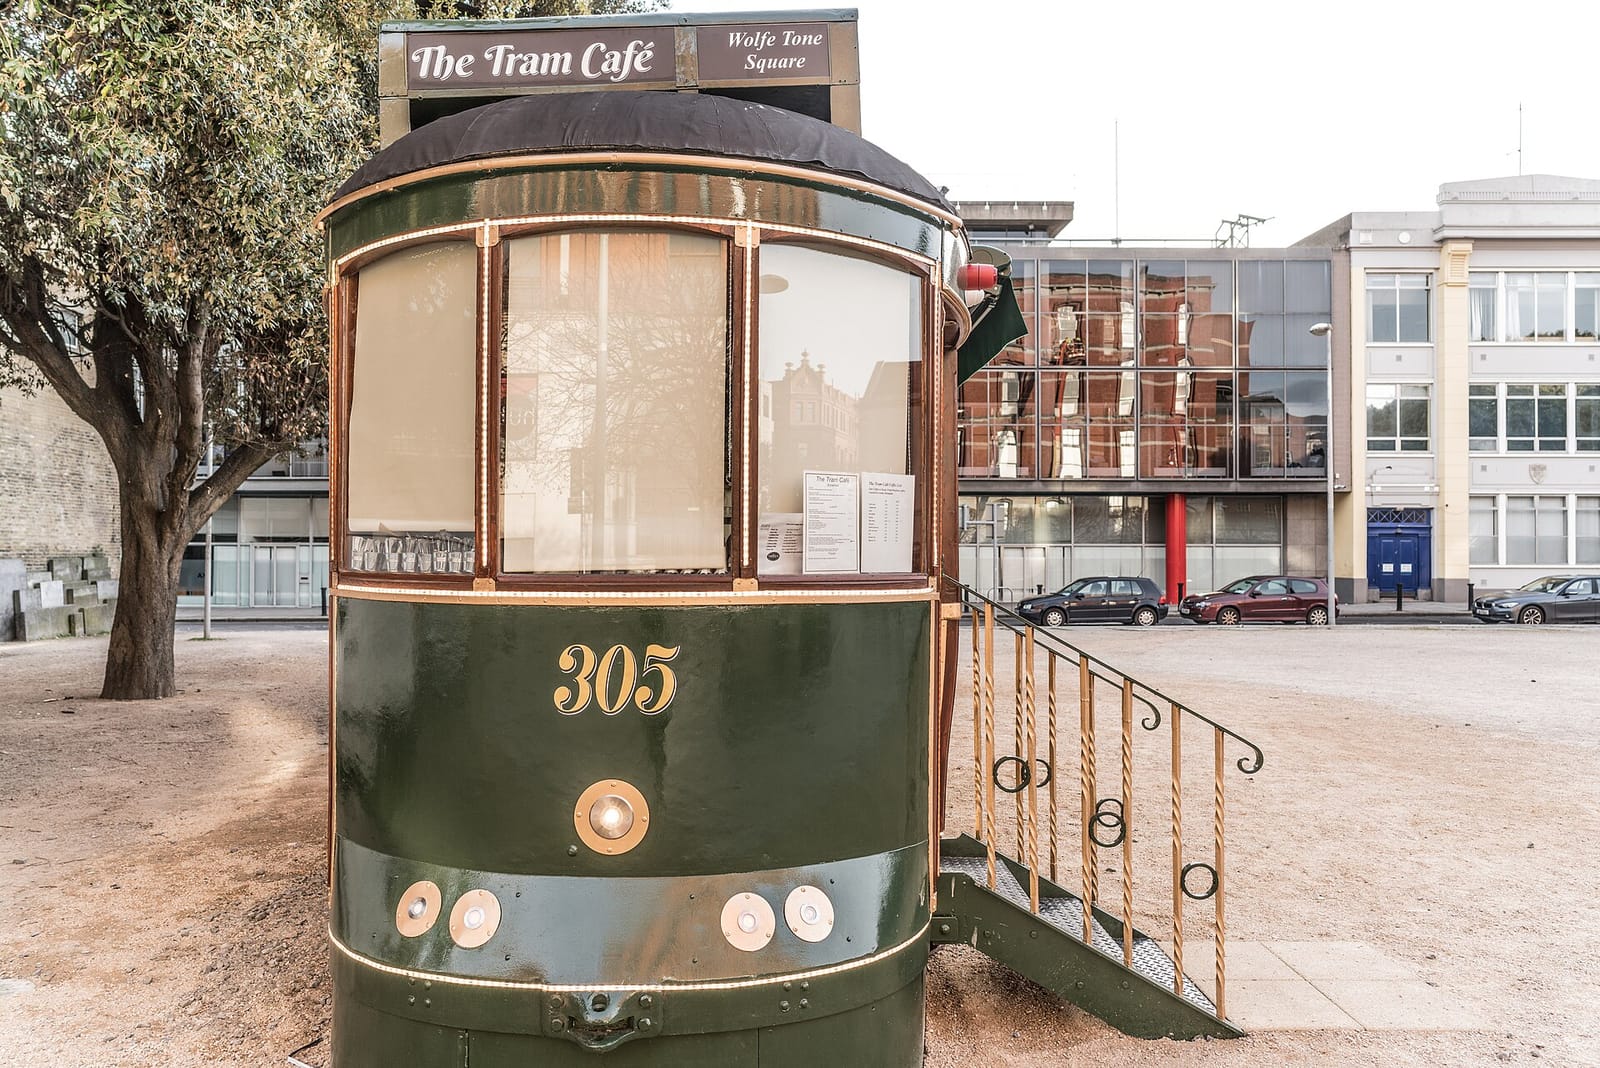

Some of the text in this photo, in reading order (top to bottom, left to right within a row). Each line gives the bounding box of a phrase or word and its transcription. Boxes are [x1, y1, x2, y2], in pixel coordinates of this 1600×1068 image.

[728, 30, 823, 51] Wolfe Tone
[411, 39, 656, 83] The Tram Café
[744, 53, 806, 74] Square
[553, 644, 680, 716] 305
